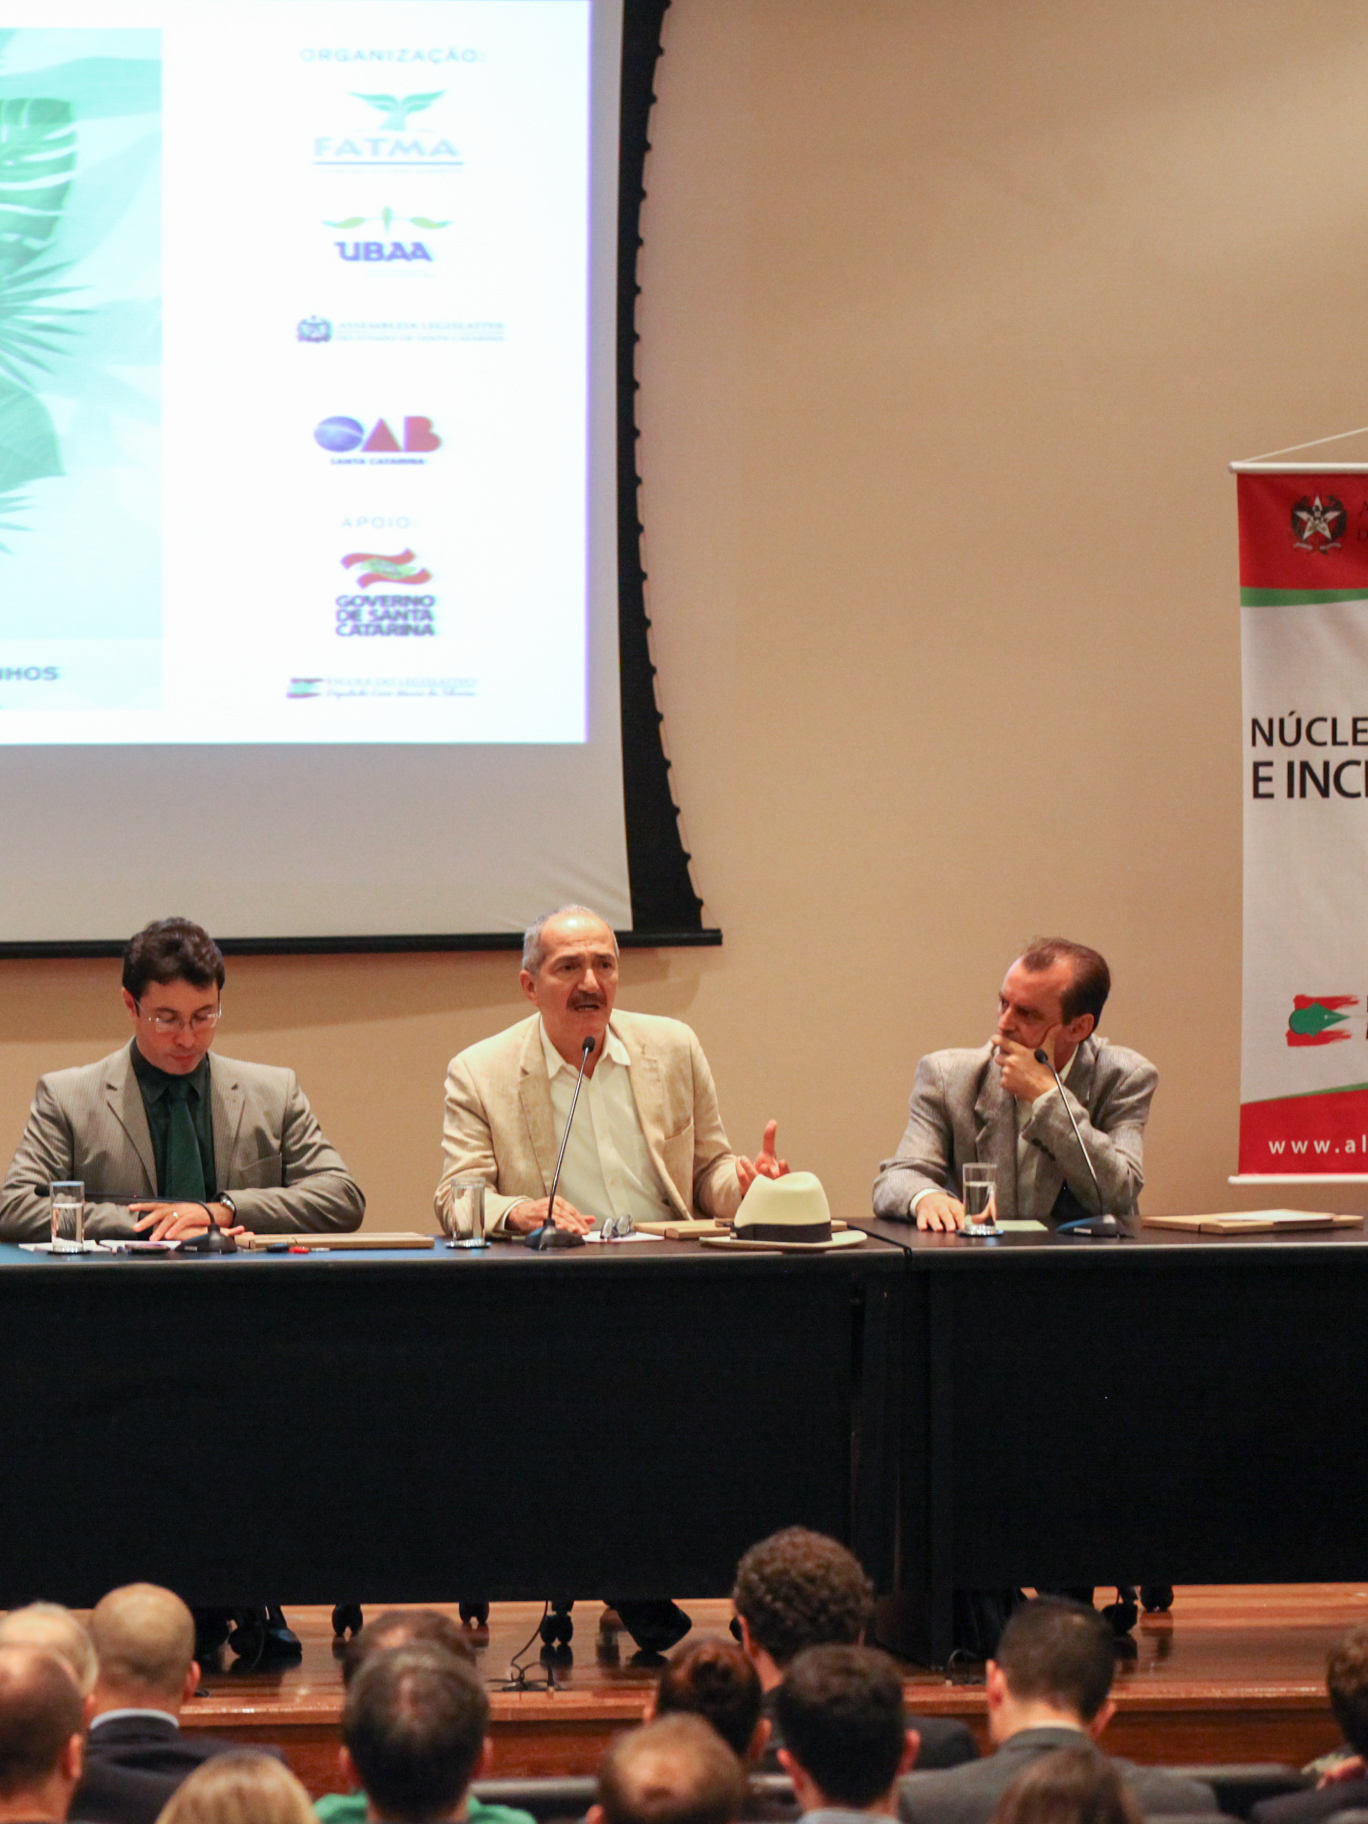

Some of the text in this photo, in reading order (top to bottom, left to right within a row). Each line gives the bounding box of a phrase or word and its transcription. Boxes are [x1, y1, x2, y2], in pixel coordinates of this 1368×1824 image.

[313, 137, 460, 157] FATMA
[334, 241, 433, 262] UBAA
[314, 415, 441, 452] OAB
[335, 595, 435, 608] GOVERNO
[335, 608, 434, 622] DE SANTA
[335, 623, 435, 636] CATARINA
[1253, 760, 1368, 799] E INC
